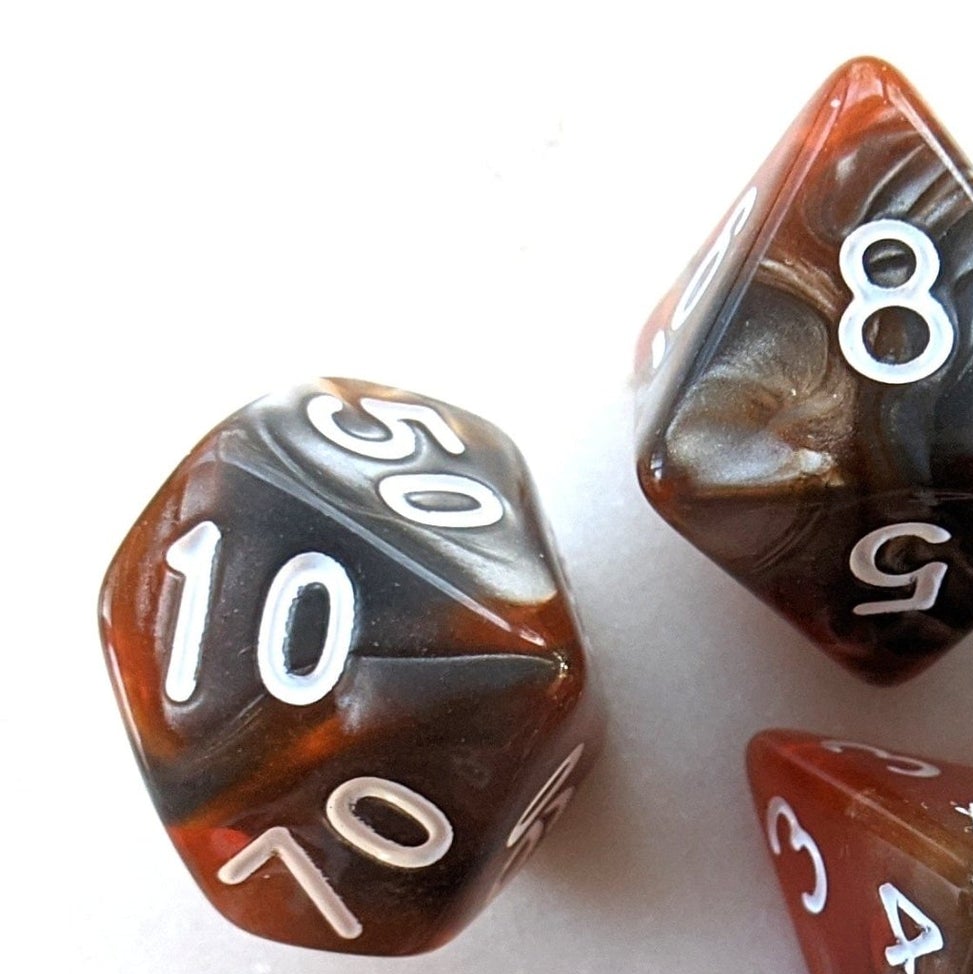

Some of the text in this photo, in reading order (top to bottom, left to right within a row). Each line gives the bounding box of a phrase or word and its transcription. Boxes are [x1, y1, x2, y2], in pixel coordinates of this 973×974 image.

[839, 219, 954, 384] 8
[307, 395, 504, 528] 50
[166, 521, 355, 706] 10
[850, 522, 951, 616] 5
[217, 776, 454, 939] 70
[767, 796, 827, 914] 3
